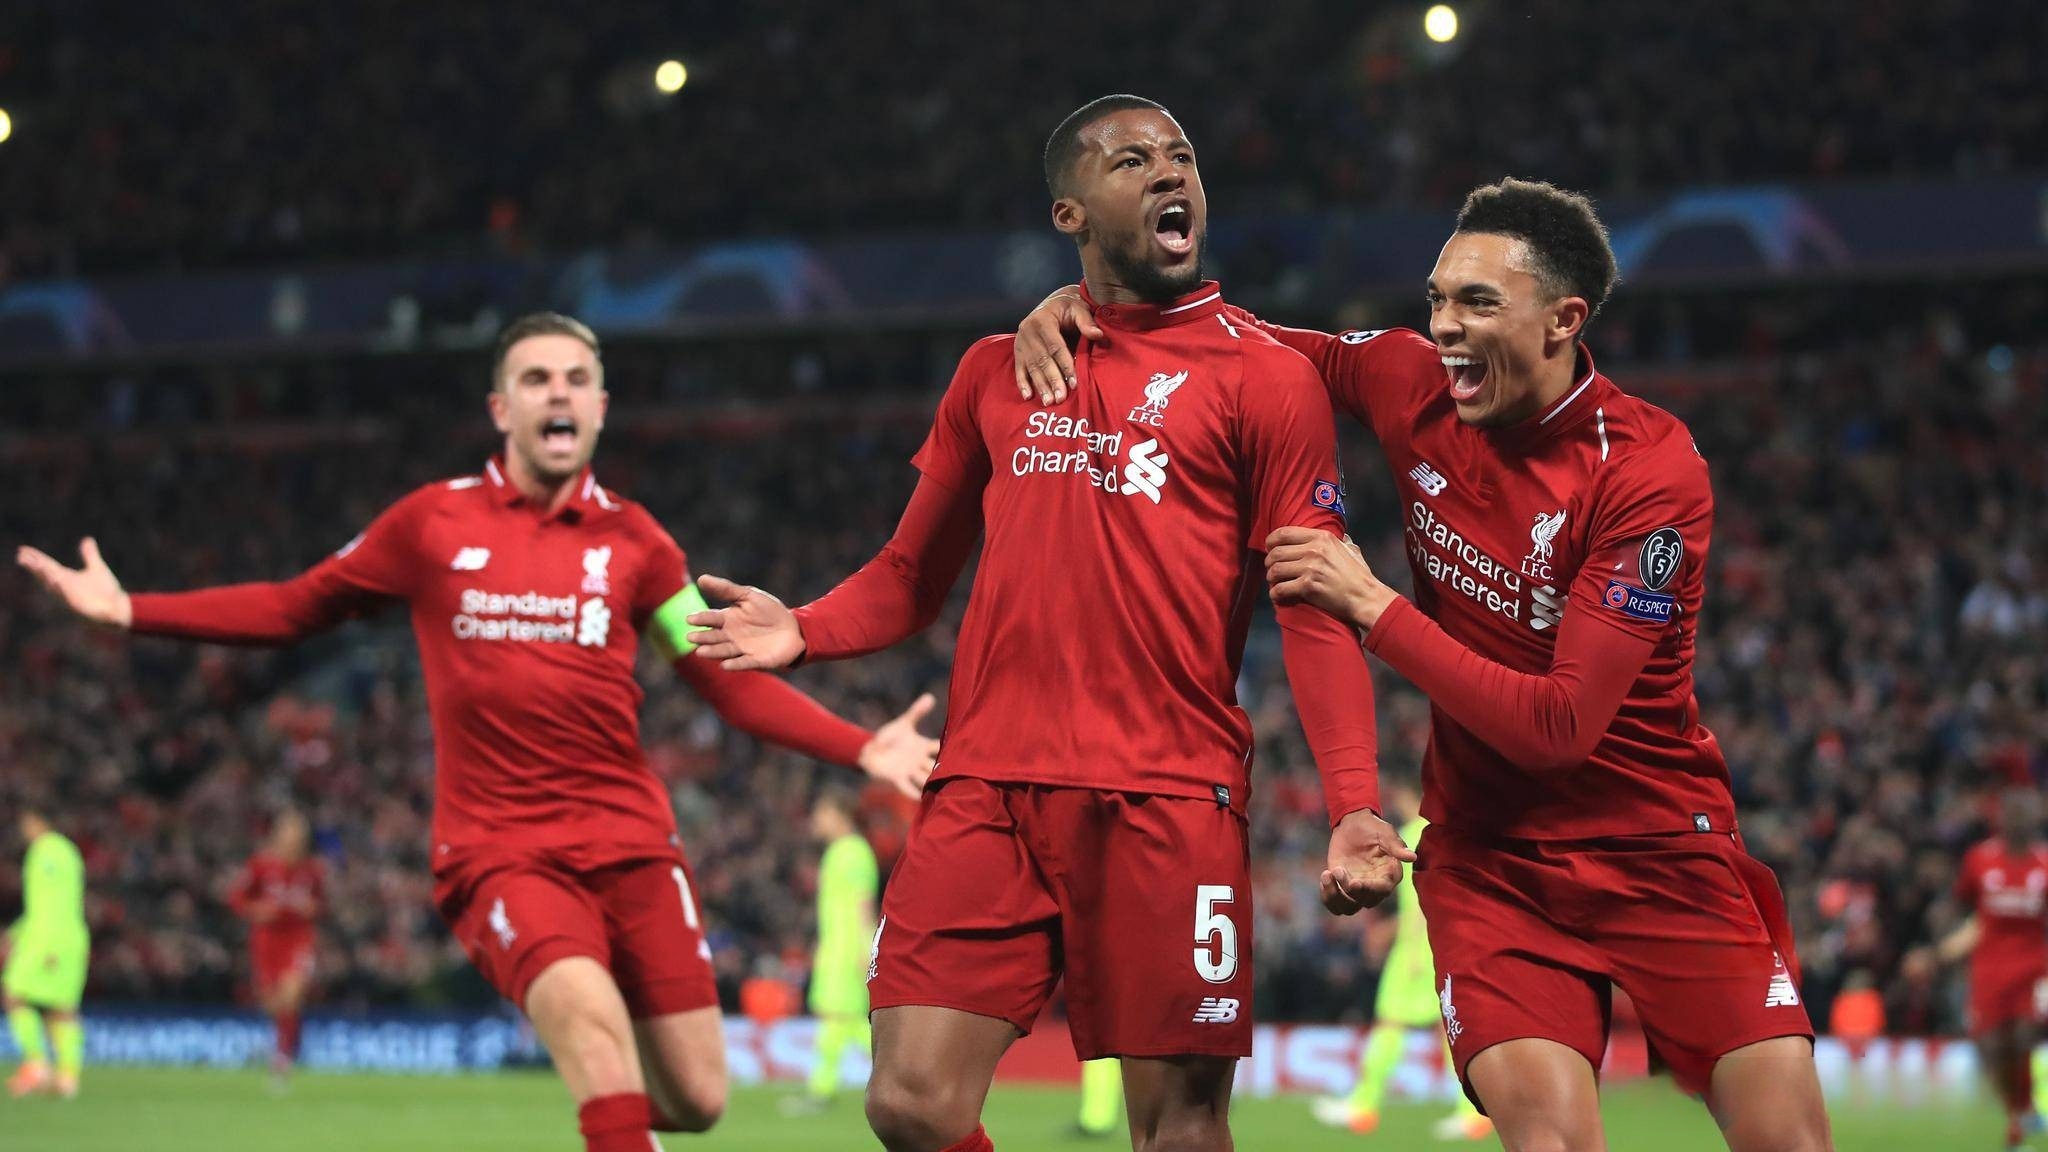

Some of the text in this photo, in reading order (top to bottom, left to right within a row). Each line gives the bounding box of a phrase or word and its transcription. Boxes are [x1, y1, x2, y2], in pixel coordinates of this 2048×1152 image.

[1012, 445, 1118, 493] Chareed
[1654, 558, 1667, 575] 5
[461, 588, 577, 619] Standard
[1628, 596, 1673, 616] RESPECT
[452, 613, 576, 643] Chartered
[1193, 884, 1238, 984] 5
